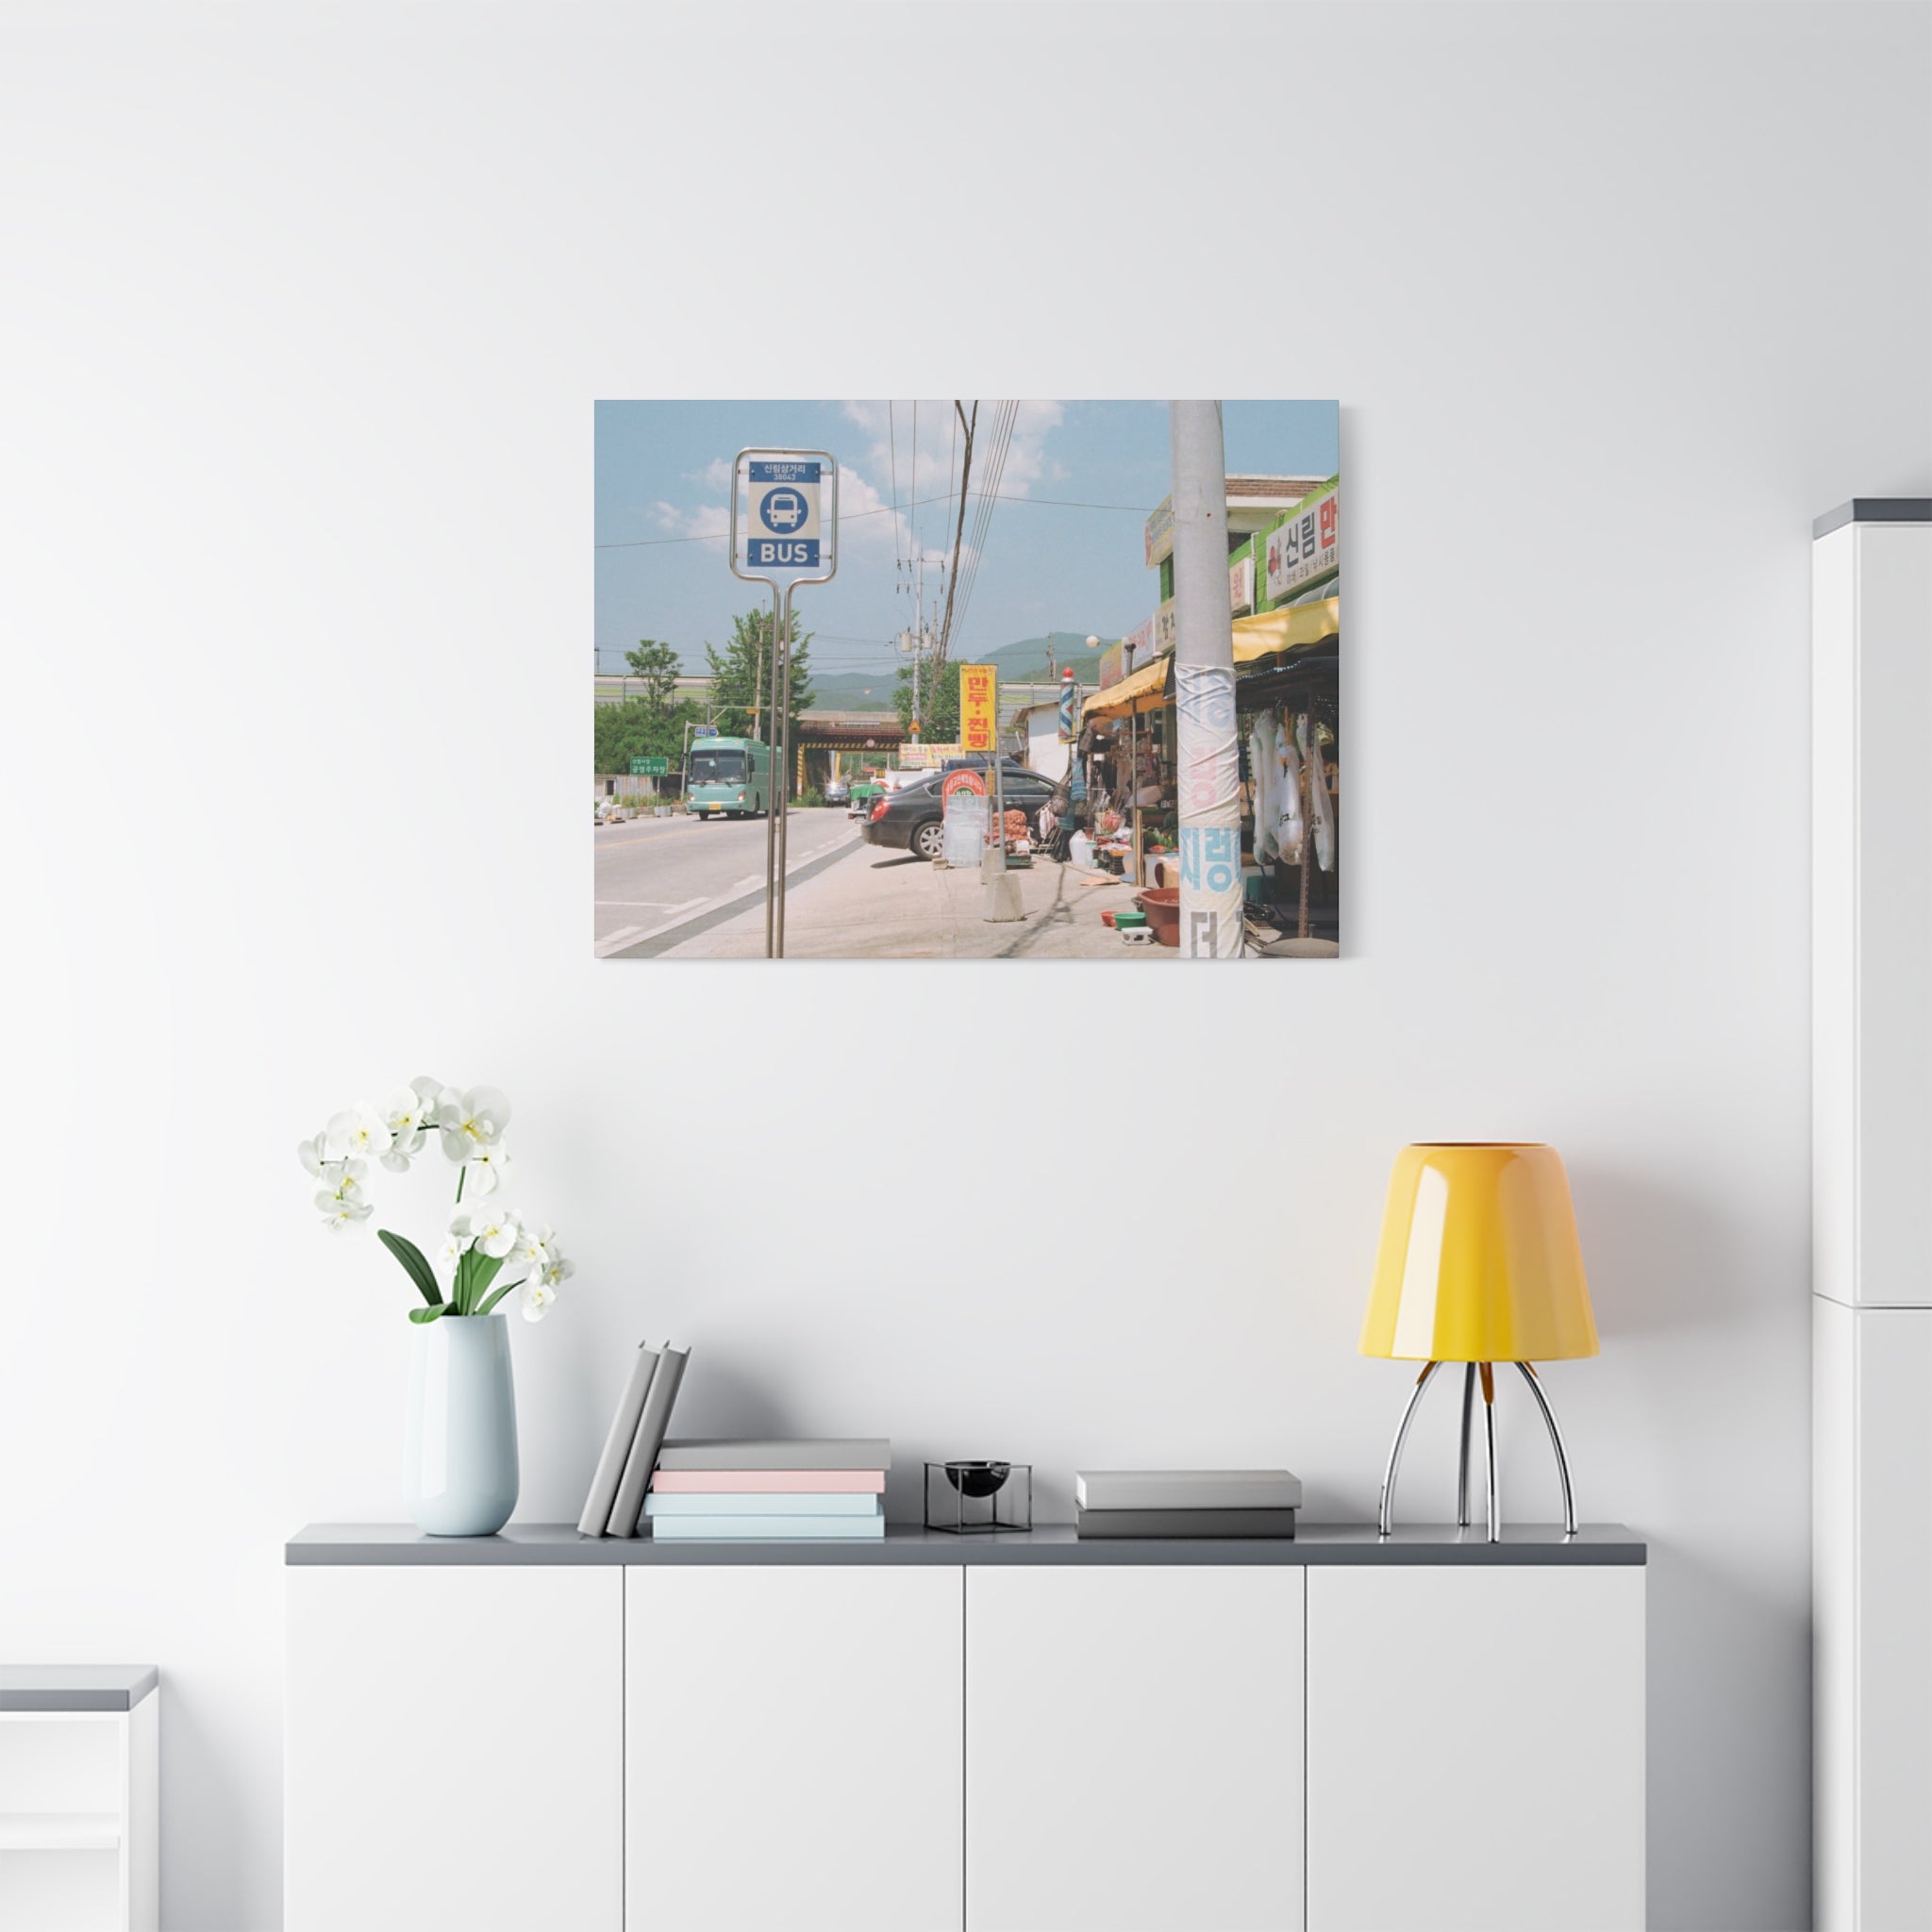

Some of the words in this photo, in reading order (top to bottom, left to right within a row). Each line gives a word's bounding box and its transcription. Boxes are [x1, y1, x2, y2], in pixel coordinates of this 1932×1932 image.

[764, 464, 806, 474] 신림삼거리
[1286, 511, 1315, 569] 신림
[760, 543, 808, 563] BUS
[632, 765, 666, 774] 공영주차장
